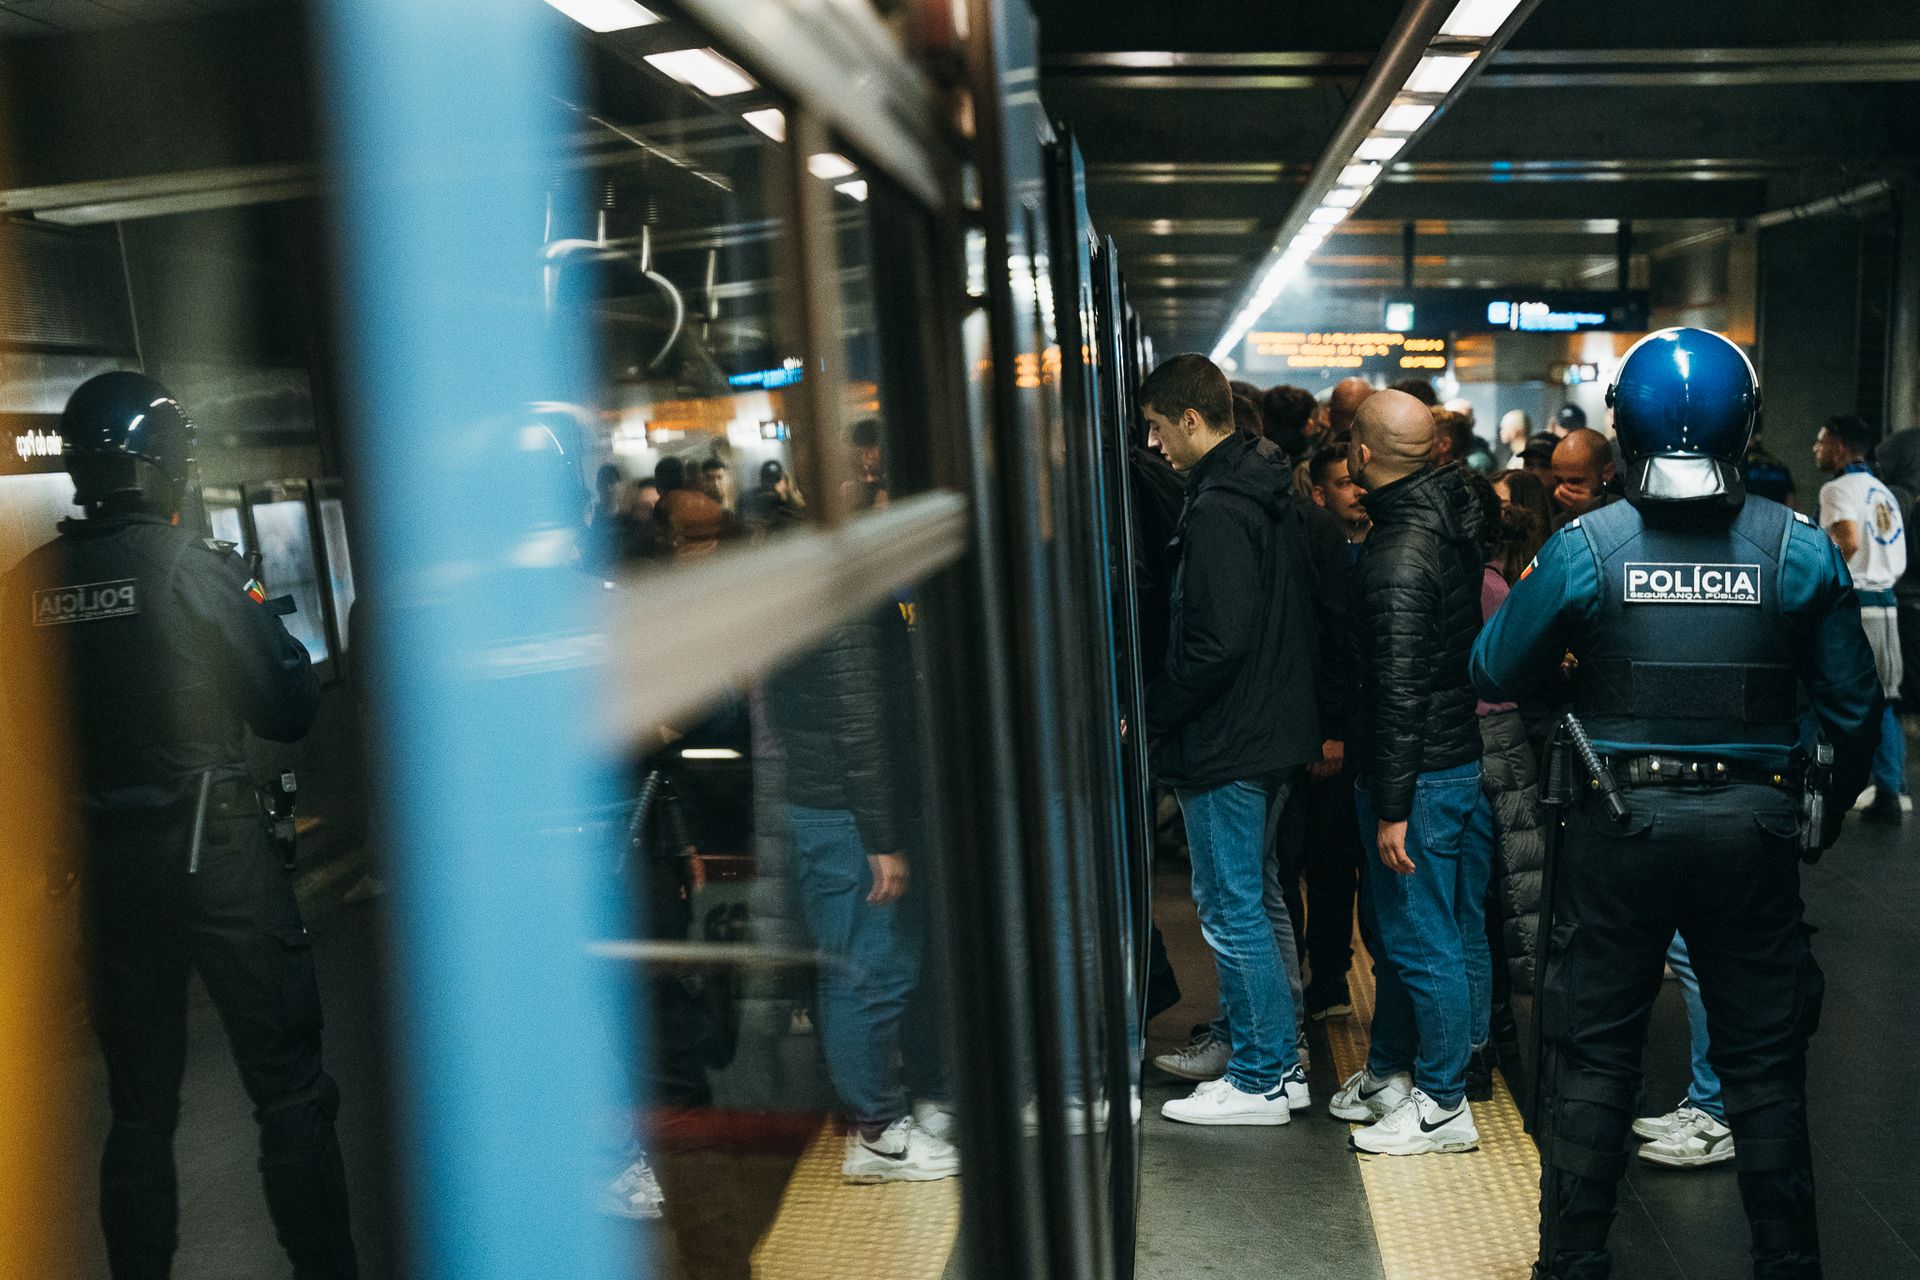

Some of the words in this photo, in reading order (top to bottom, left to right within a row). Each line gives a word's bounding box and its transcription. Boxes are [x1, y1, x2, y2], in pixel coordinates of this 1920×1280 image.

[1629, 566, 1755, 594] POLÍCIA
[1629, 592, 1702, 600] SEGURANÇA
[1705, 592, 1755, 601] PÚBLICA
